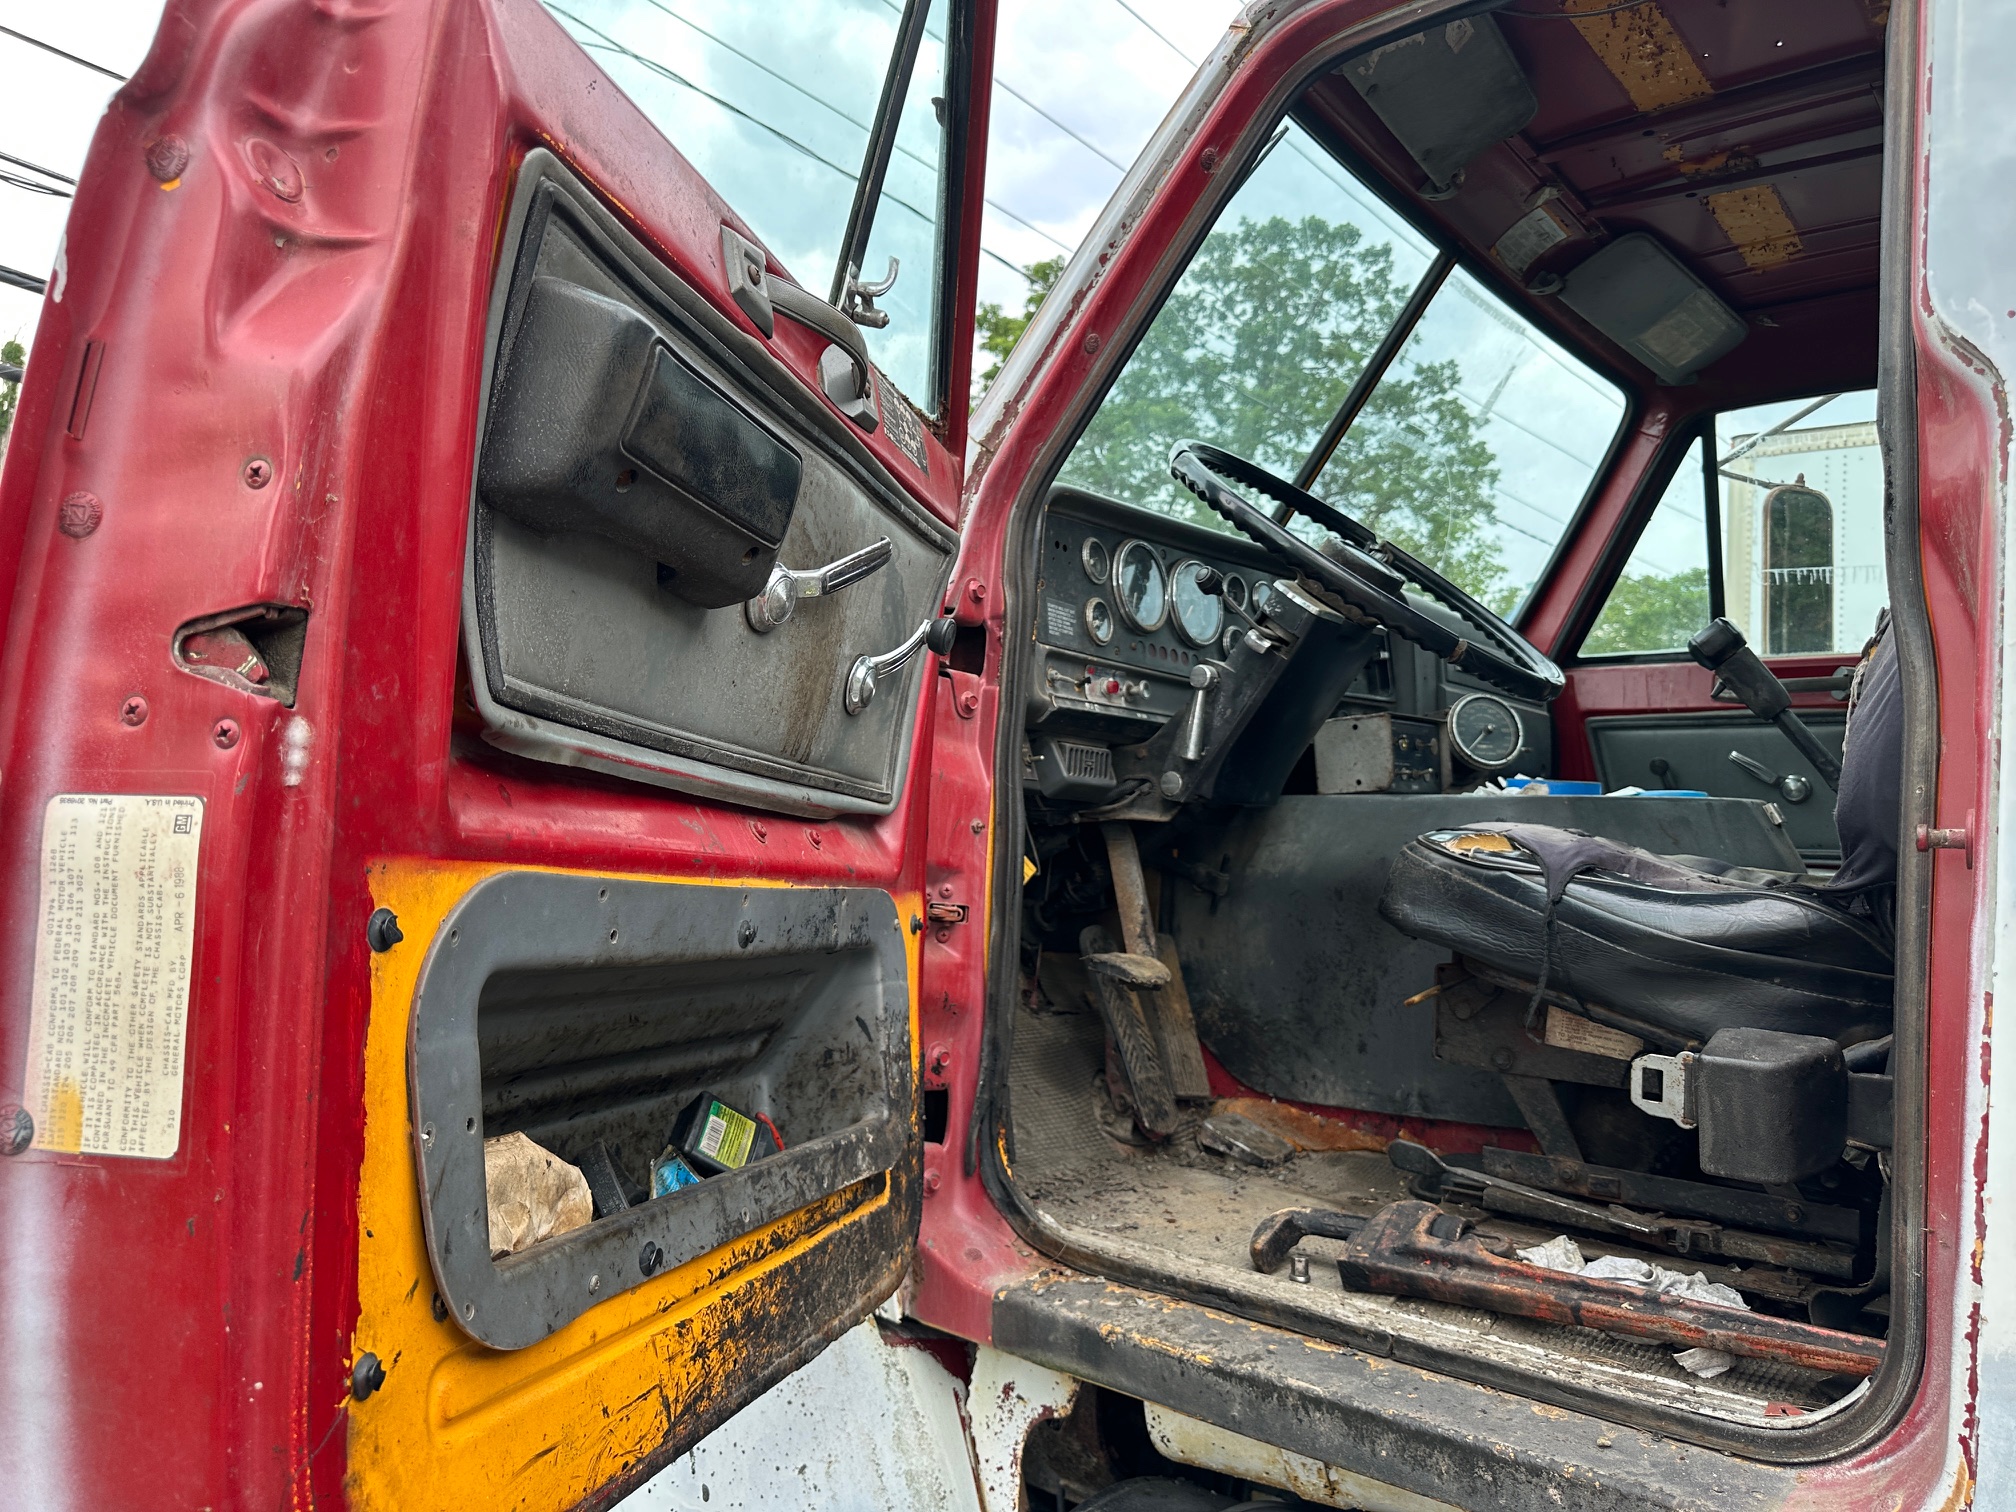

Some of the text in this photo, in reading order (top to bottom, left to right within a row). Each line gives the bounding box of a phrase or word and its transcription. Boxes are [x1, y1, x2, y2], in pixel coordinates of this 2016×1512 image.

[173, 799, 195, 807] Printed
[97, 807, 107, 823] 121
[174, 815, 188, 832] GM
[69, 817, 78, 835] 113
[67, 843, 75, 860] 111
[102, 806, 116, 880] INSTRUCTIONS
[49, 848, 57, 872] 1268
[66, 867, 74, 885] 107
[146, 832, 157, 913] SUBSTANTIALLY
[173, 866, 184, 887] 1988
[66, 892, 74, 910] 106
[75, 900, 83, 917] 211
[64, 917, 72, 935] 104
[145, 921, 153, 939] NOT
[173, 911, 184, 932] APR
[73, 924, 81, 942] 210
[89, 912, 99, 961] STANDARD
[62, 942, 70, 960] 103
[71, 949, 79, 968] 209
[144, 946, 151, 957] IS
[60, 967, 69, 986] 102
[69, 974, 77, 993] 208
[87, 969, 95, 981] TO
[92, 806, 125, 1149] CONTAINED IN THE INCOMPLETE VEHICLE DOCUMENT FURNISHED
[95, 944, 106, 1006] ACCORDANCE
[150, 966, 159, 984] THE
[36, 831, 67, 1144] THIS CHASSIS-CAB CONFORMS TO FEDERAL MOTOR VEHICLE
[119, 827, 149, 1151] CONFORMITY TO THE OTHER SAFETY STANDARDS APPLICABLE
[138, 966, 150, 1016] COMPLETE
[58, 994, 67, 1011] 101
[148, 992, 155, 1004] OF
[67, 999, 75, 1018] 207
[84, 987, 93, 1032] CONFORM
[111, 1002, 119, 1027] PART
[162, 960, 176, 1076] CHASSIS-CAB MFD BY
[93, 1013, 101, 1025] IN
[65, 1024, 74, 1043] 206
[145, 1010, 154, 1049] DESIGN
[166, 954, 186, 1128] 510 GENERAL MOTORS CORP
[63, 1050, 72, 1069] 205
[82, 1039, 91, 1064] WILL
[89, 1033, 100, 1090] COMPLETED
[109, 1059, 116, 1071] 49
[144, 1056, 152, 1073] THE
[51, 1049, 62, 1100] STANDARD
[106, 1078, 115, 1090] TO
[133, 1055, 143, 1099] VEHICLE
[77, 1071, 88, 1114] VEHICLE
[143, 1081, 150, 1093] BY
[86, 1097, 94, 1108] IS
[85, 1117, 92, 1127] IT
[101, 1098, 113, 1149] PURSUANT
[130, 1106, 139, 1131] THIS
[138, 1100, 149, 1152] AFFECTED
[83, 1136, 90, 1147] IF
[128, 1138, 136, 1151] TO
